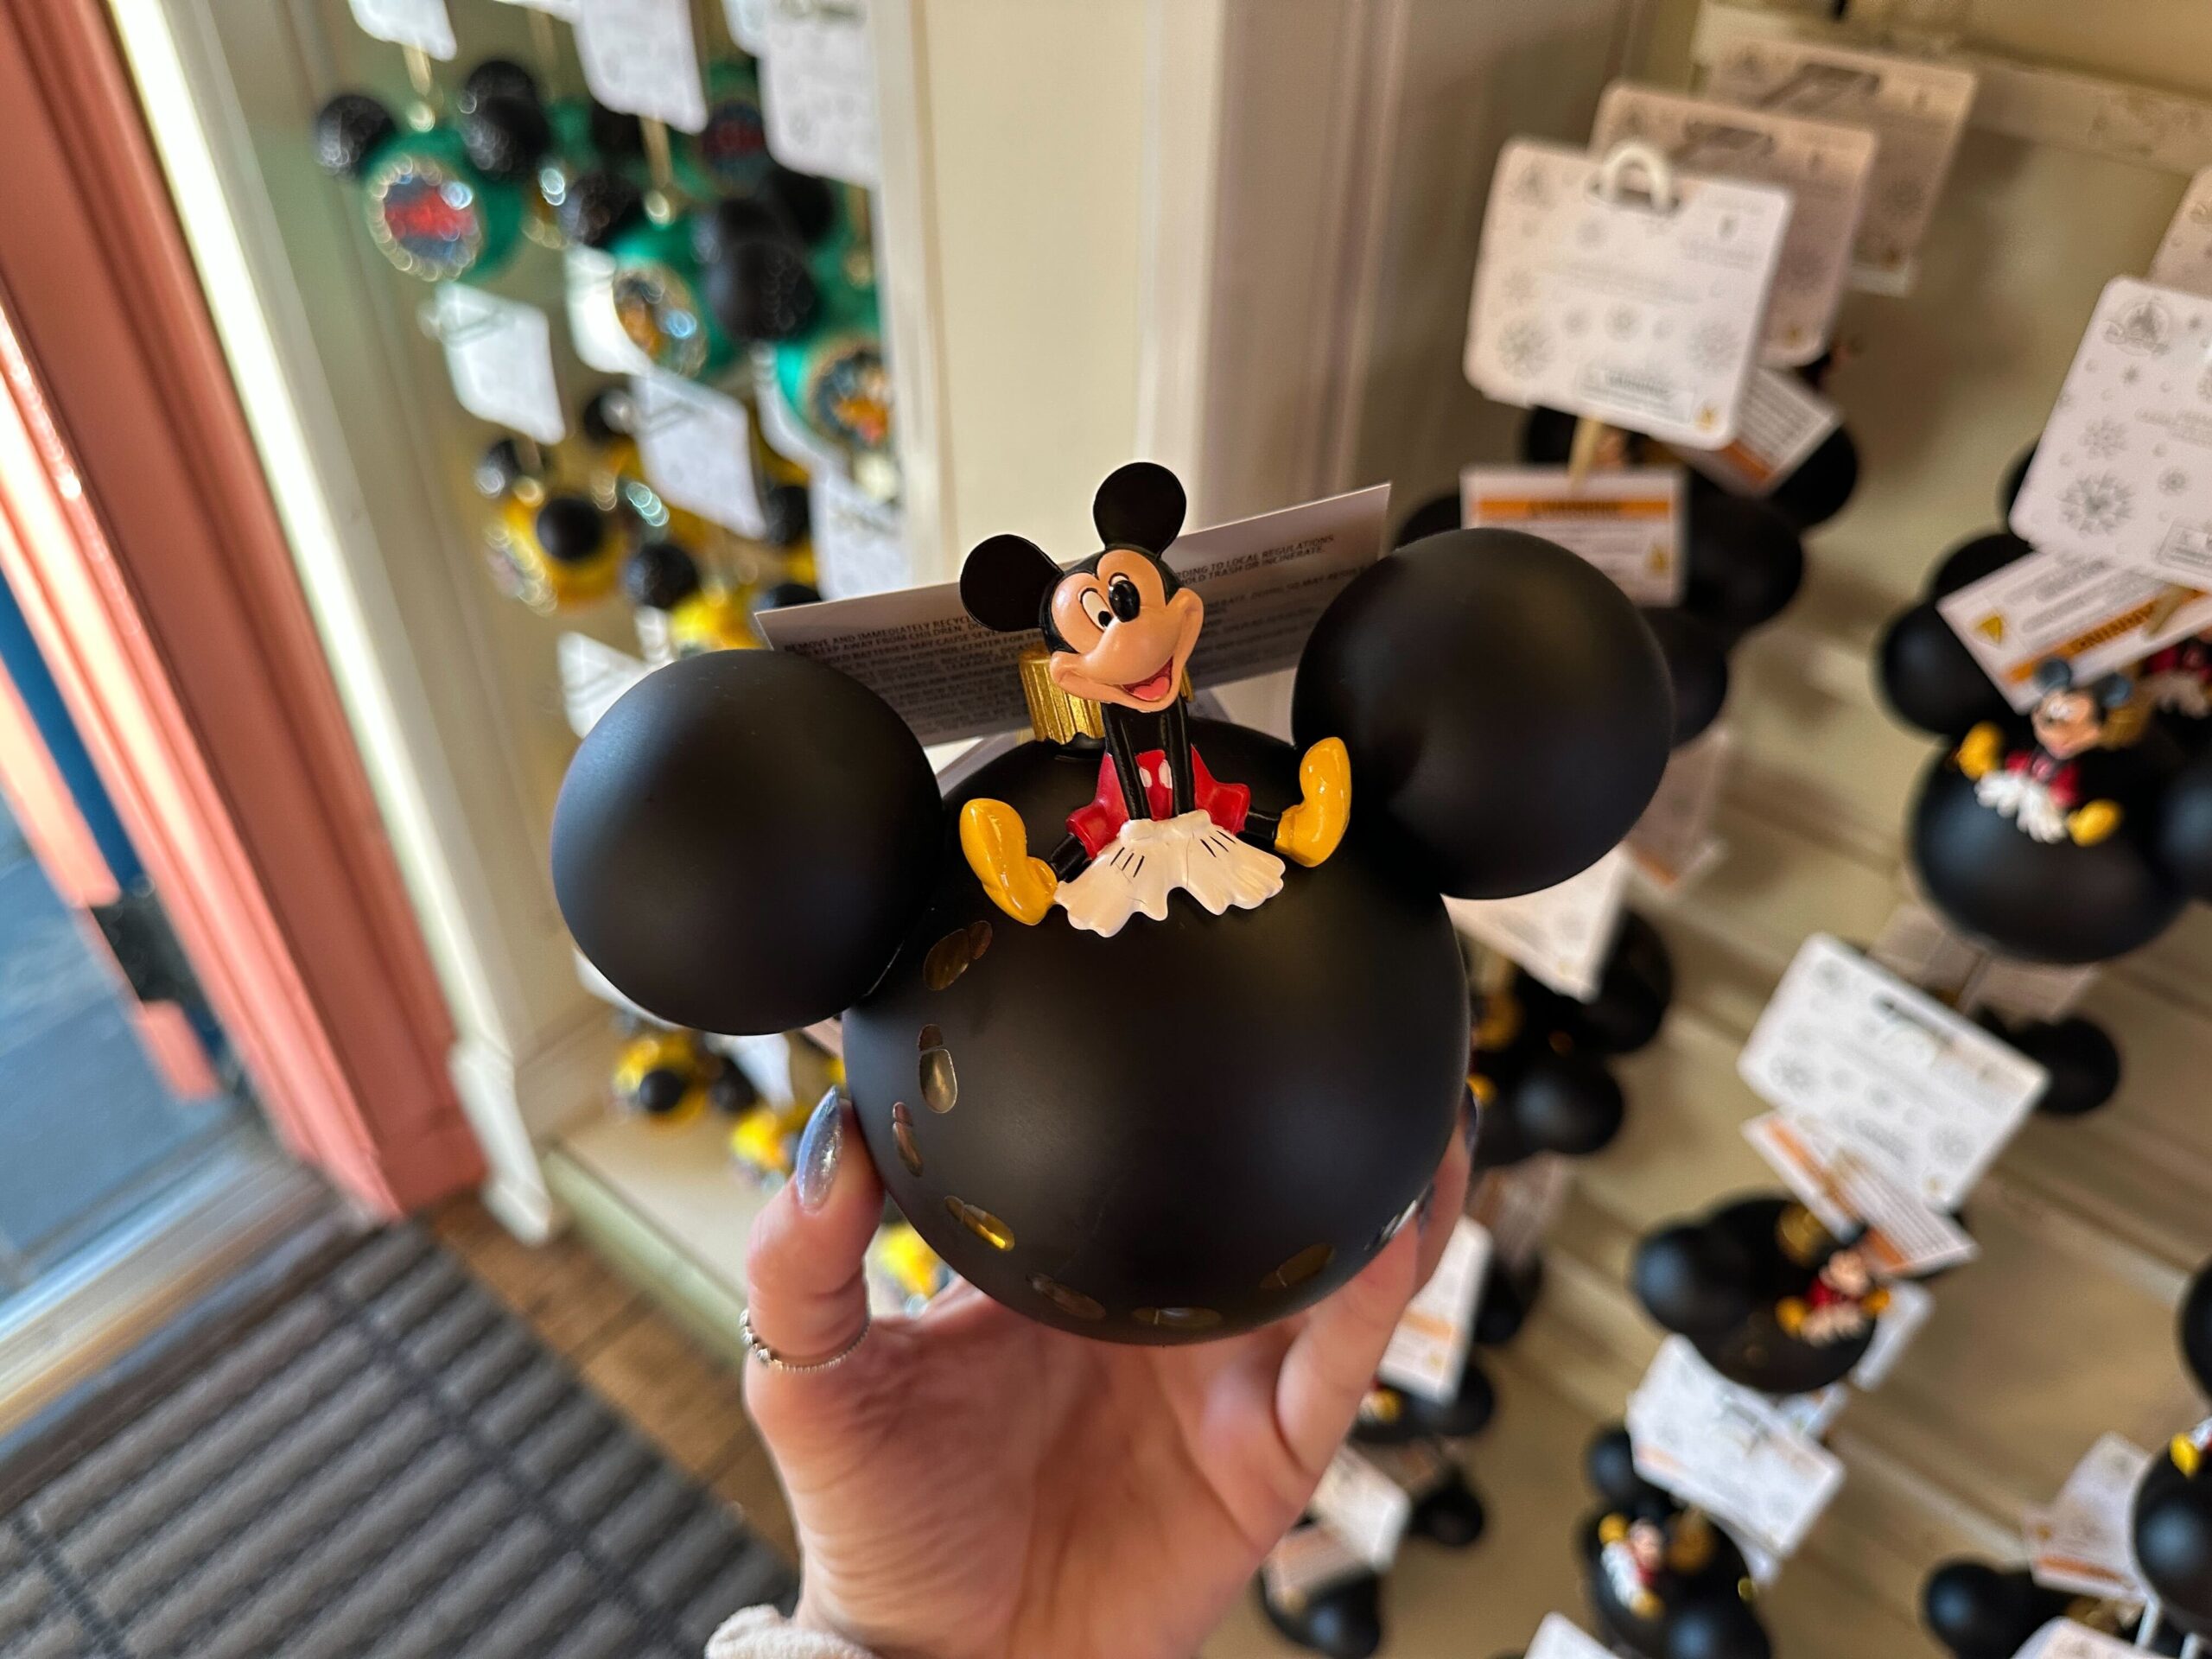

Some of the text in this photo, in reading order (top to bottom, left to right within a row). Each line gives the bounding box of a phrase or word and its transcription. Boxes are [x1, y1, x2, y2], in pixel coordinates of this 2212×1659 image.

[784, 535, 1334, 652] REMOVE AND IMMEDIATELY RECYCL RDING TO LOCAL REGULATIONS
[843, 639, 873, 651] AWAY
[875, 634, 907, 645] FROM
[1209, 565, 1242, 580] TRASH
[1245, 561, 1259, 570] OR
[853, 645, 907, 659] BATTERIES
[910, 640, 933, 650] MAY
[936, 633, 969, 646] CAUSE
[972, 629, 996, 639] SEVE
[962, 639, 1001, 651] CENTER
[1002, 634, 1023, 645] FOR
